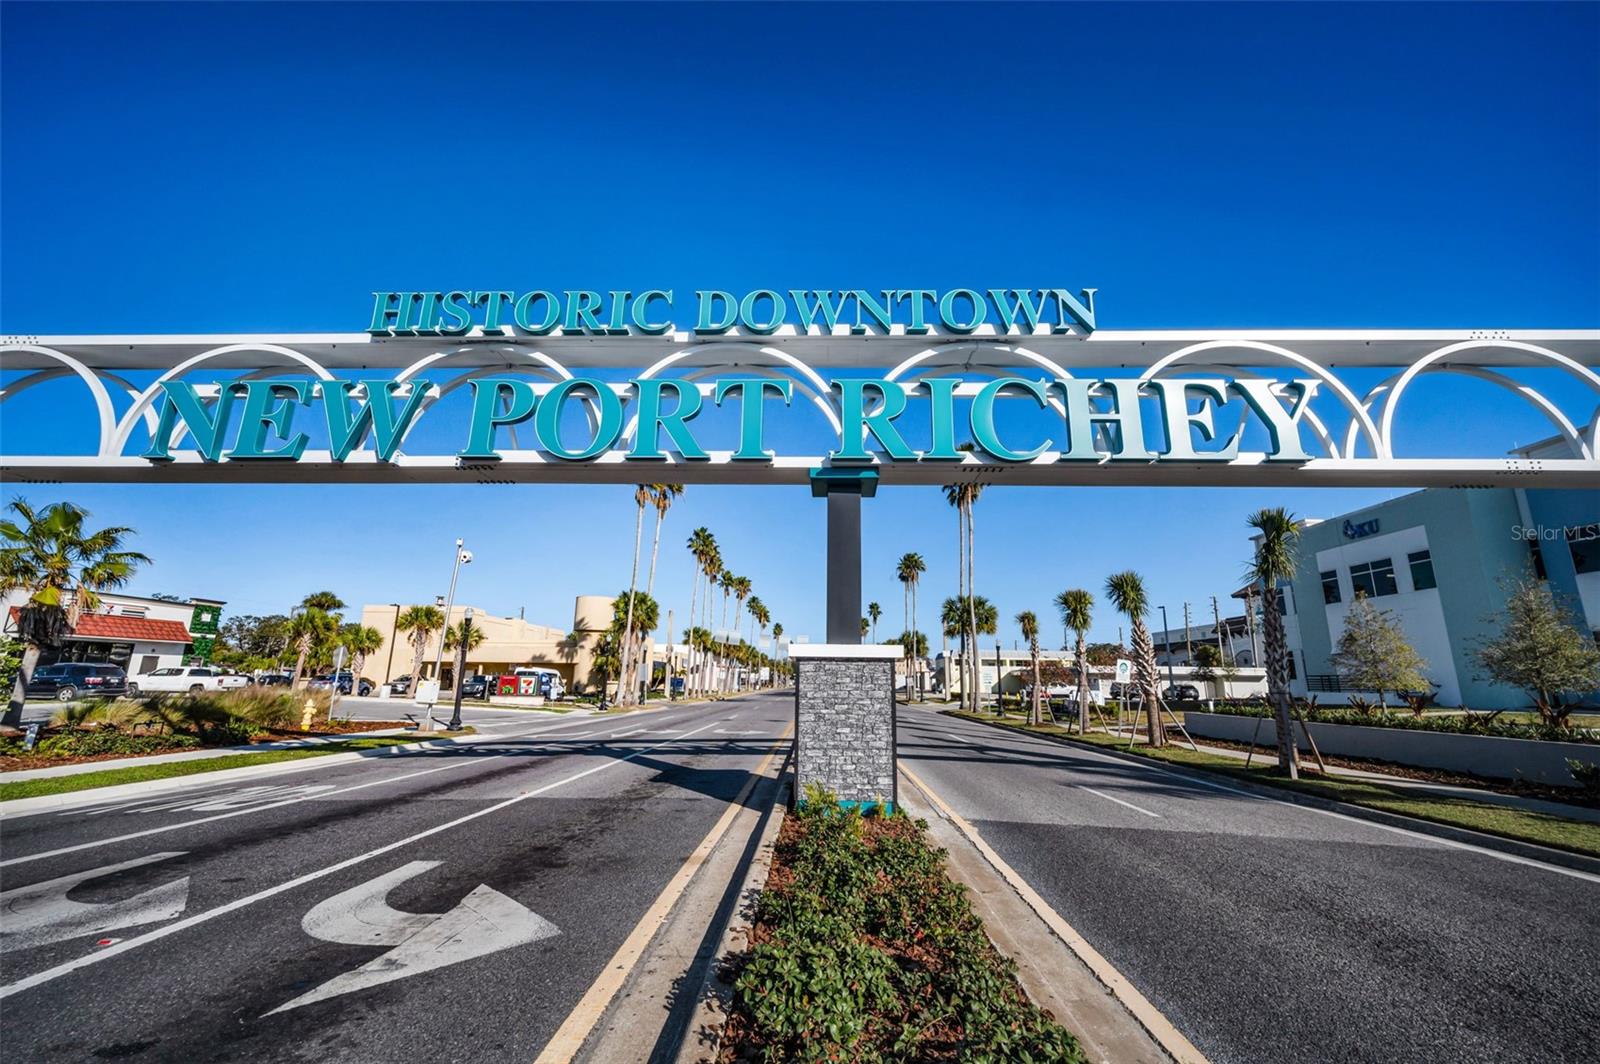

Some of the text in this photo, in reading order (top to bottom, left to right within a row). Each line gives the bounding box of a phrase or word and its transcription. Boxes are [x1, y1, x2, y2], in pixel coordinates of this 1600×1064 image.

[367, 288, 1098, 336] HISTORIC DOWNTOWN
[139, 376, 1323, 462] NEW PORT RICHEY
